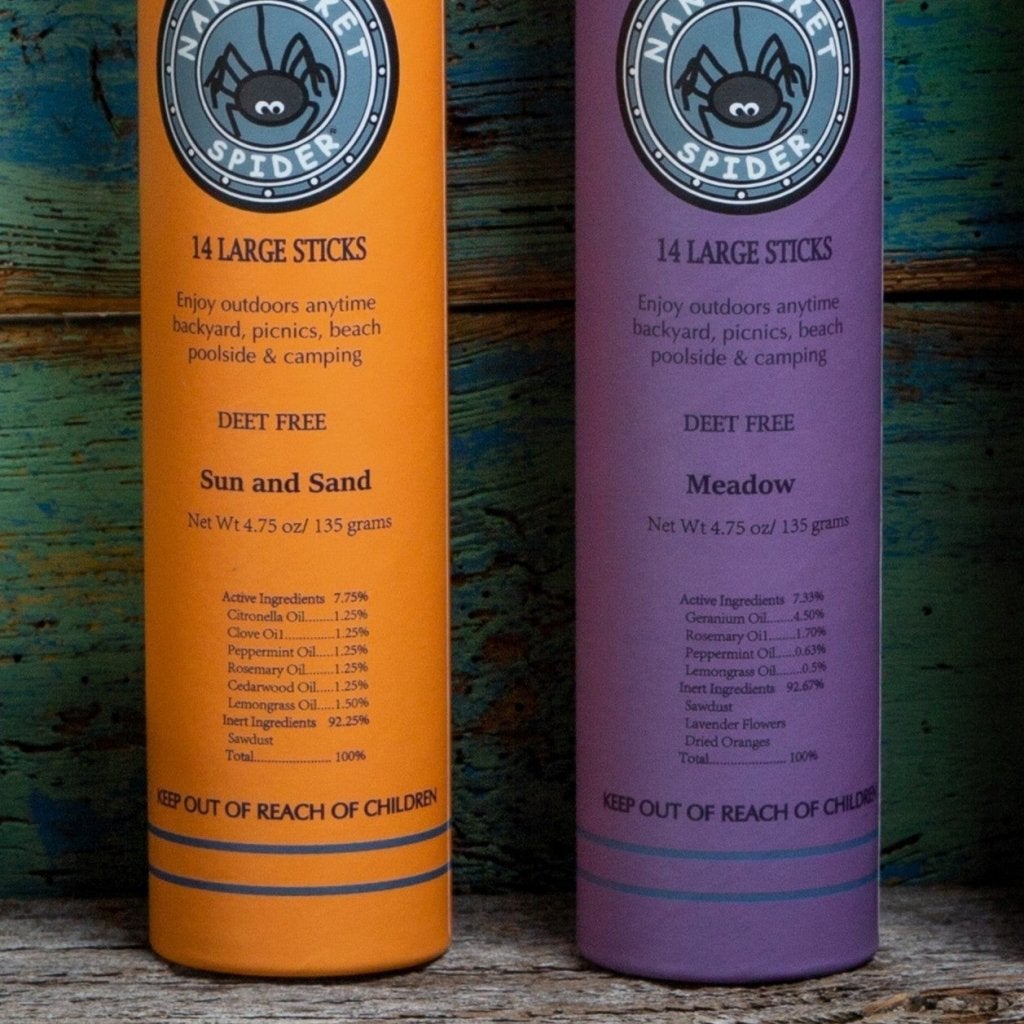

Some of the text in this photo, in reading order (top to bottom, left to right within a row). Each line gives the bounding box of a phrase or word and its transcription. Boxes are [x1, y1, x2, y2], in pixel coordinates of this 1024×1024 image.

[206, 133, 340, 178] SPIDER
[676, 134, 811, 180] SPIDER
[192, 235, 367, 263] 14 LARGE STICKS
[657, 235, 833, 265] 14 LARGE STICKS
[639, 294, 839, 318] Enjoy outdoors anytime
[633, 317, 843, 346] backyard, picnics, beach
[652, 347, 827, 369] poolside & camping
[218, 411, 327, 431] DEET FREE
[684, 414, 795, 432] DEET FREE
[200, 469, 372, 493] Sun and Sand
[686, 474, 796, 496] Meadow
[188, 512, 212, 529] Net
[216, 515, 239, 531] Wt
[243, 518, 277, 533] 4.75
[316, 518, 343, 533] 135
[347, 517, 392, 537] grams
[222, 591, 368, 608] Active Ingredients 7.75%
[223, 714, 369, 731] Inert Ingredients 92.25%
[685, 717, 786, 730] Lavender Flowers
[229, 733, 273, 745] Sawdust
[685, 735, 770, 751] Dried Oranges
[157, 787, 437, 821] KEEP OUT OF REACH OF CHILDREN
[602, 791, 635, 813] KEEP
[639, 799, 682, 820] OUT
[686, 803, 715, 821] OF
[721, 803, 788, 823] REACH
[794, 800, 819, 819] OF
